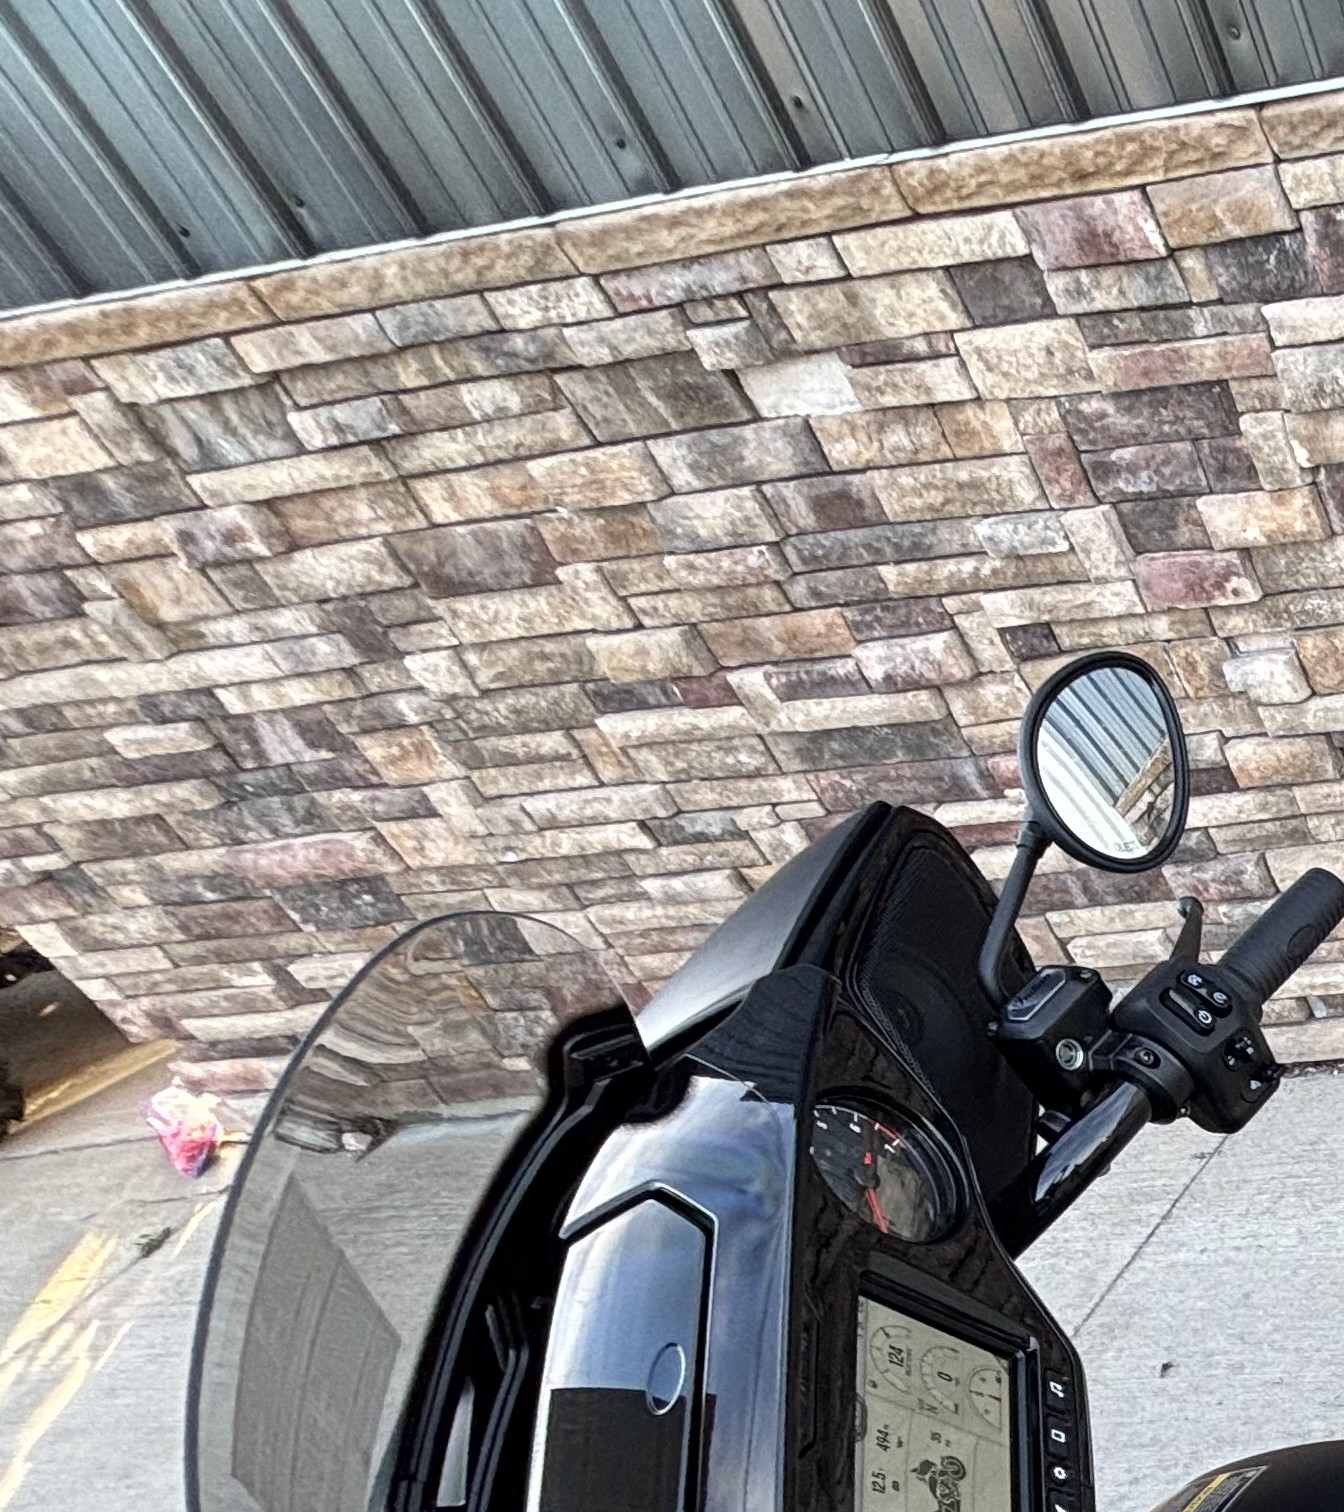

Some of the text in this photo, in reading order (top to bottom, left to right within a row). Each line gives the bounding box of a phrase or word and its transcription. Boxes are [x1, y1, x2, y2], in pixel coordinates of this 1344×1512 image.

[849, 1122, 861, 1134] 6
[888, 1344, 905, 1368] 124
[875, 1429, 890, 1451] 494
[871, 1471, 887, 1494] 12.5
